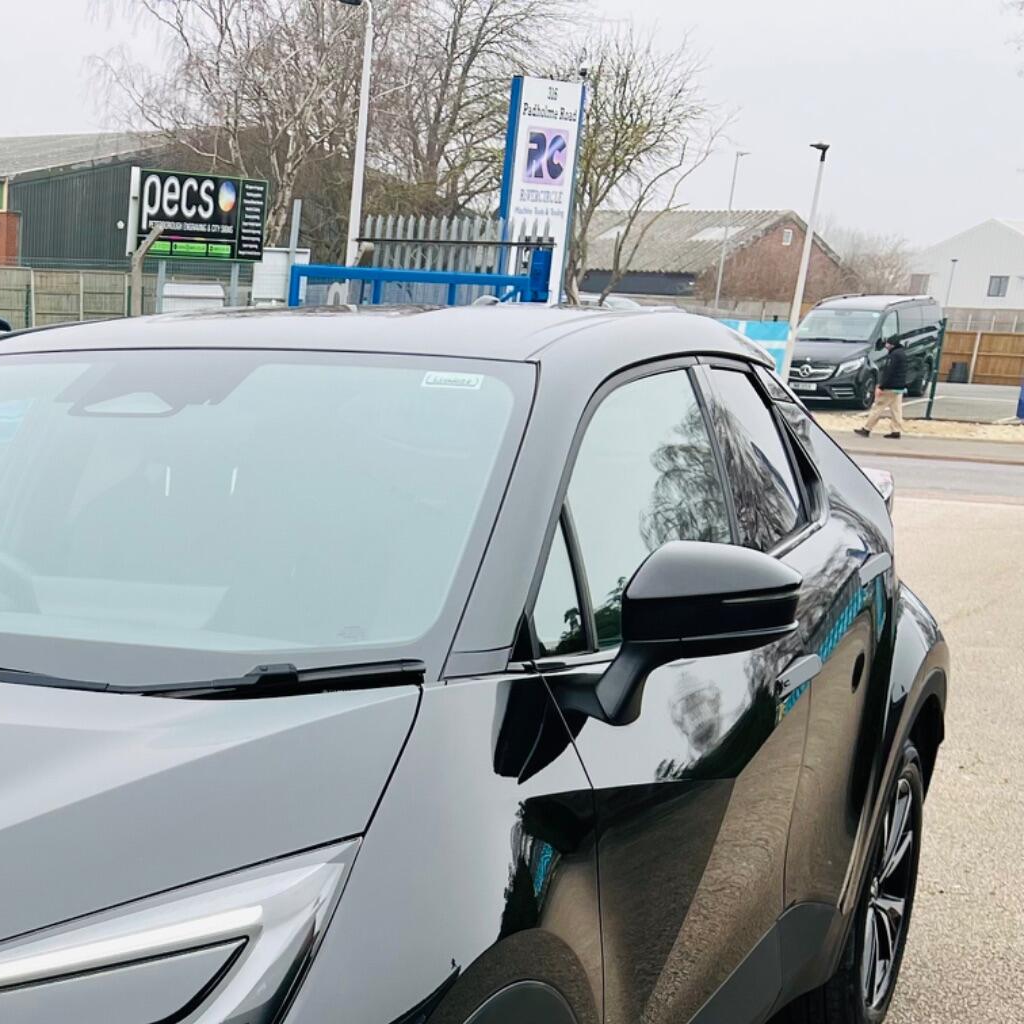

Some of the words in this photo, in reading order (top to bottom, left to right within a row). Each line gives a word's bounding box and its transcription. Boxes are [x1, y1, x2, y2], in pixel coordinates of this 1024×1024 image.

[523, 103, 559, 120] Padholme
[559, 107, 578, 122] Road
[526, 131, 566, 180] RC
[142, 174, 215, 230] pecs
